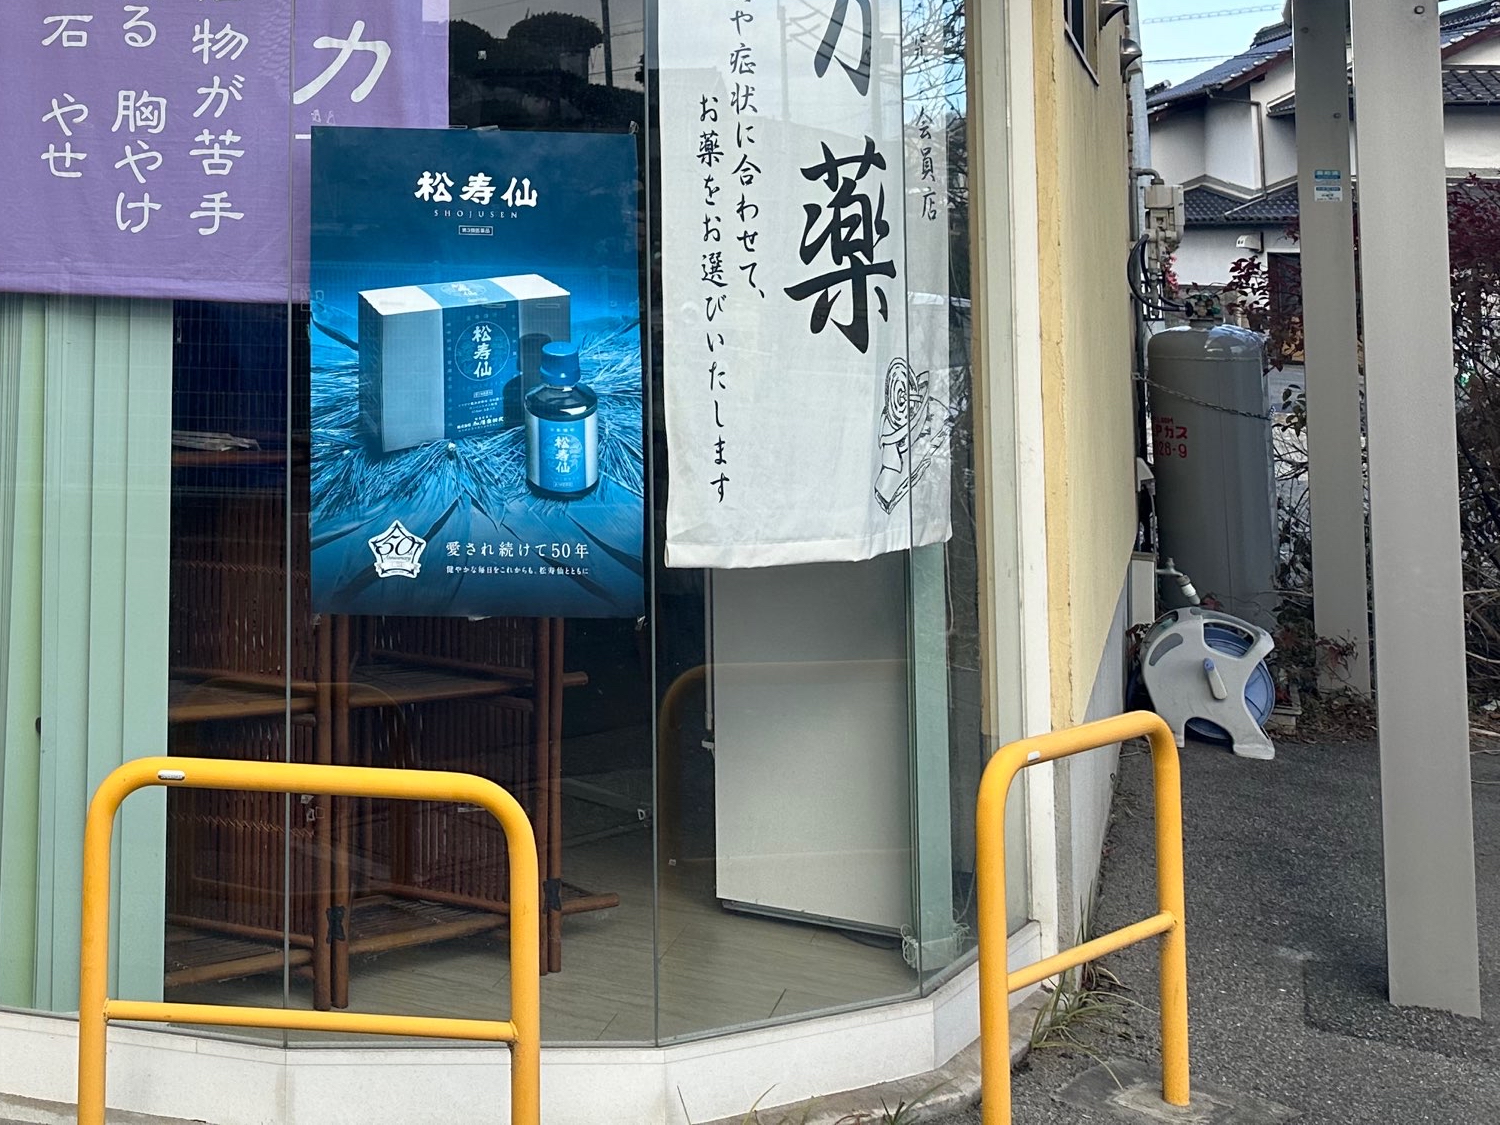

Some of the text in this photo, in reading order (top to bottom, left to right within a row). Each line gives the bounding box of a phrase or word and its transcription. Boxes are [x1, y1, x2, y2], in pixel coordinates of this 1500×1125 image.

[40, 92, 89, 179] やせ
[111, 89, 167, 235] 胸やけ
[414, 171, 538, 208] 松寿仙
[434, 210, 518, 219] SHOJUSEN
[696, 94, 731, 504] お薬をお選びいたします
[471, 325, 493, 378] 松寿仙
[554, 436, 571, 473] 松寿仙
[376, 535, 415, 556] 50
[446, 541, 589, 559] 愛され続けて50年
